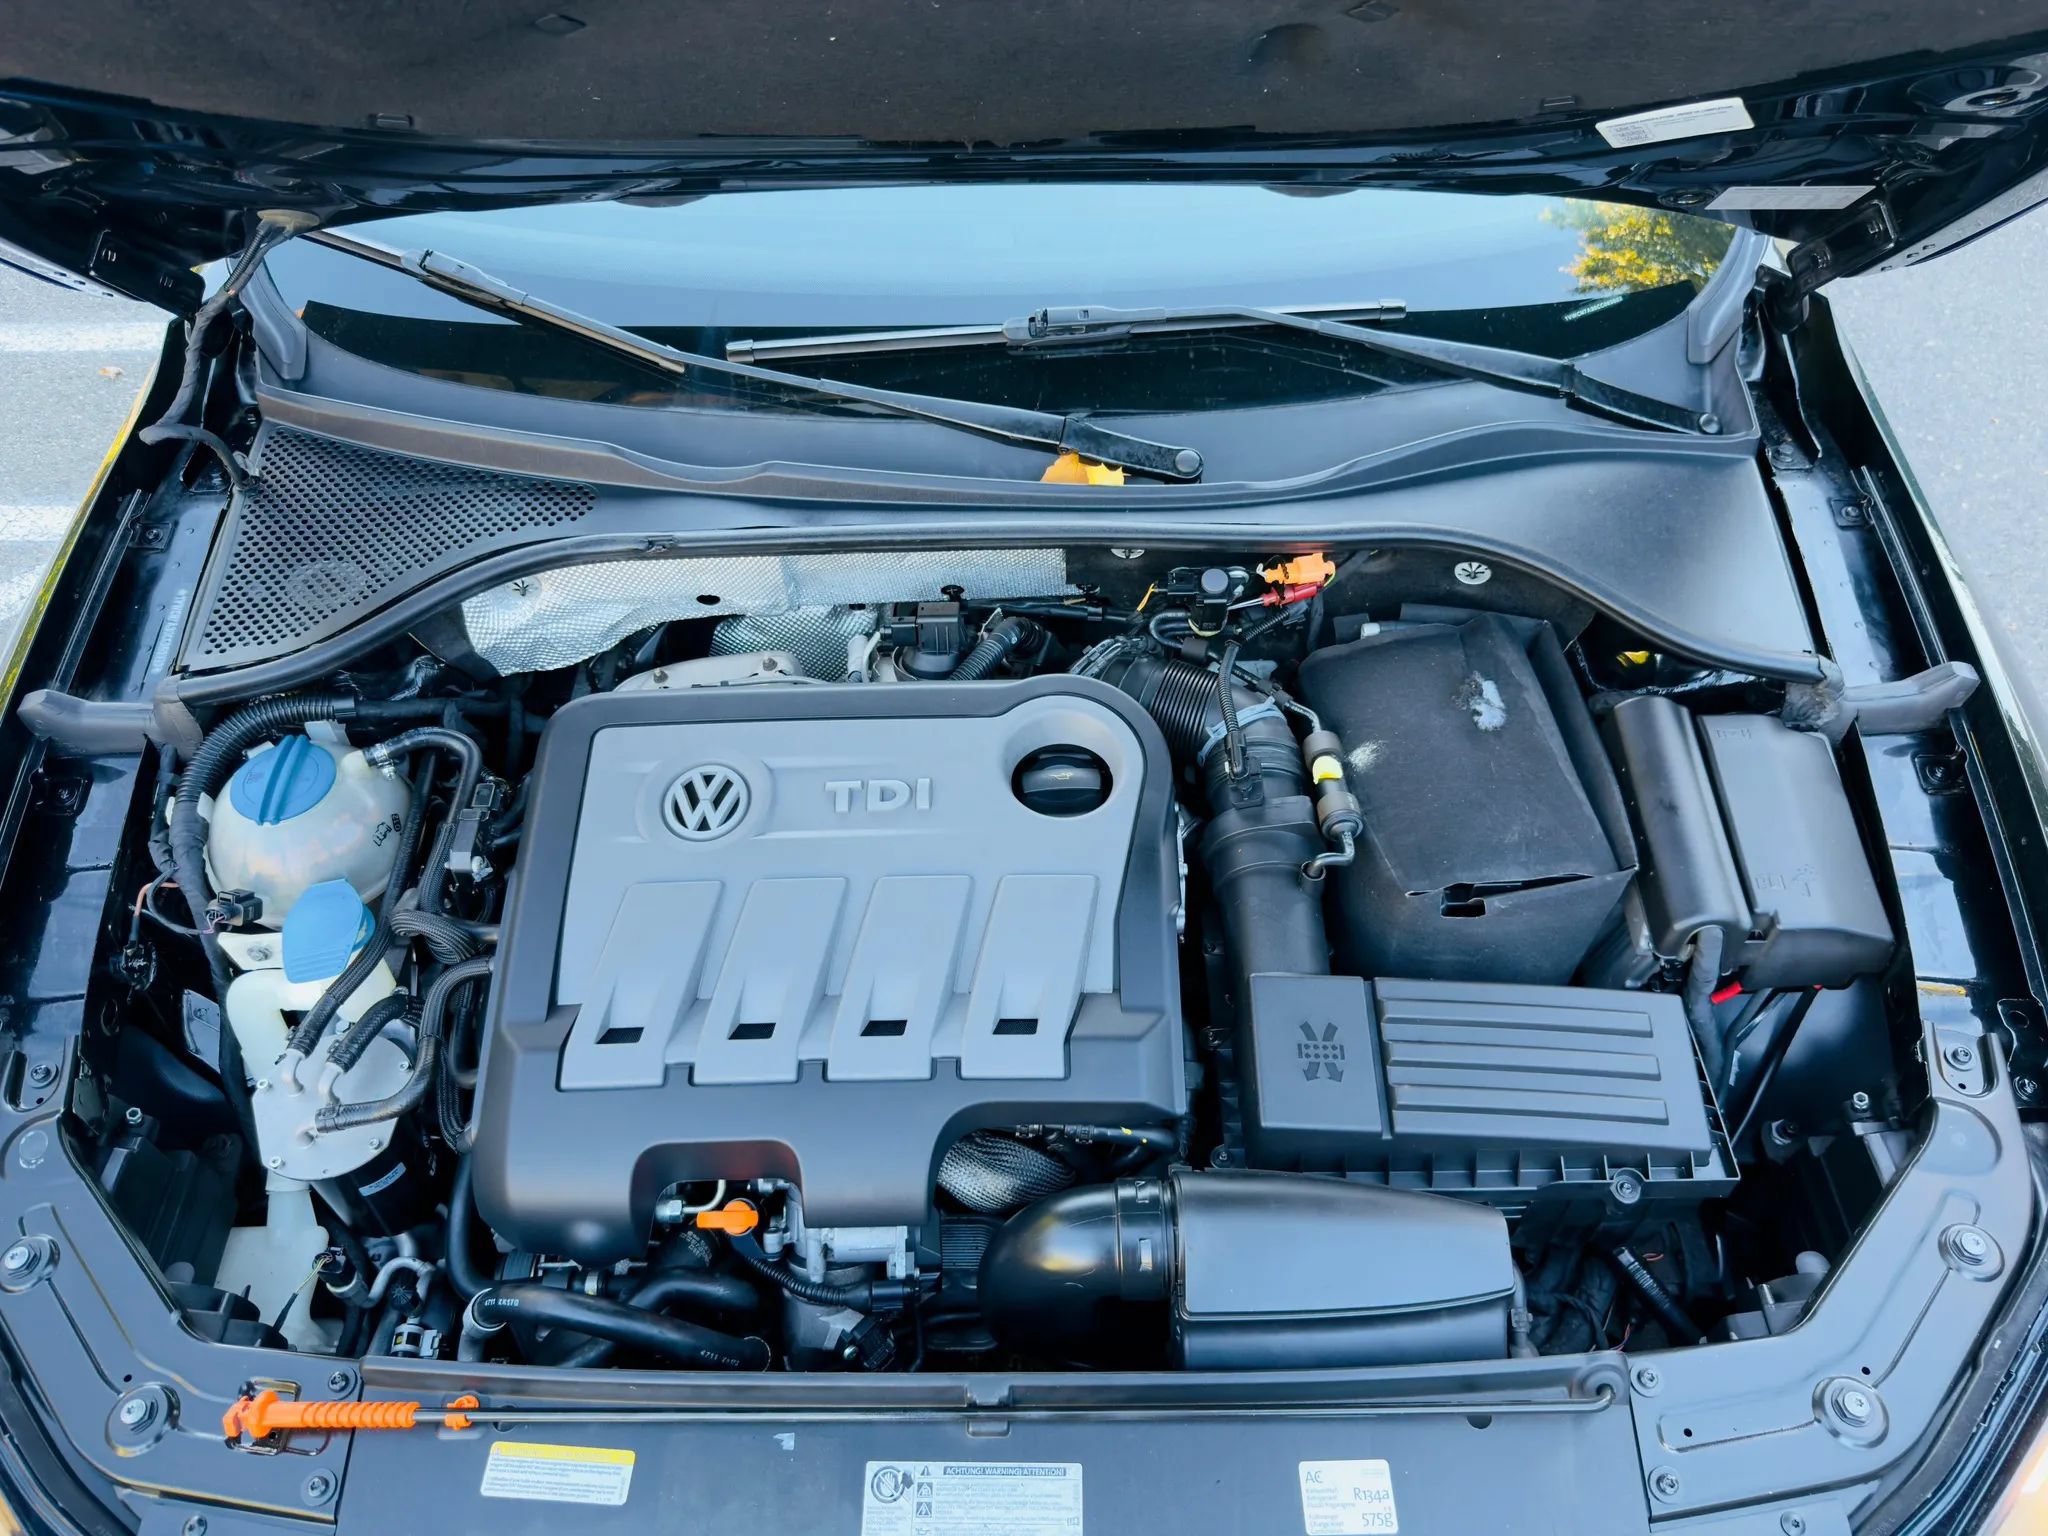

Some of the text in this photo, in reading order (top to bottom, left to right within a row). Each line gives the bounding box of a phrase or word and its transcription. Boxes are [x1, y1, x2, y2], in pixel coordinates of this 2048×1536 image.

[668, 767, 744, 836] VW
[825, 777, 933, 813] TDI
[1305, 1470, 1324, 1484] AC
[1353, 1487, 1390, 1503] R134a
[1361, 1512, 1394, 1528] 575g
